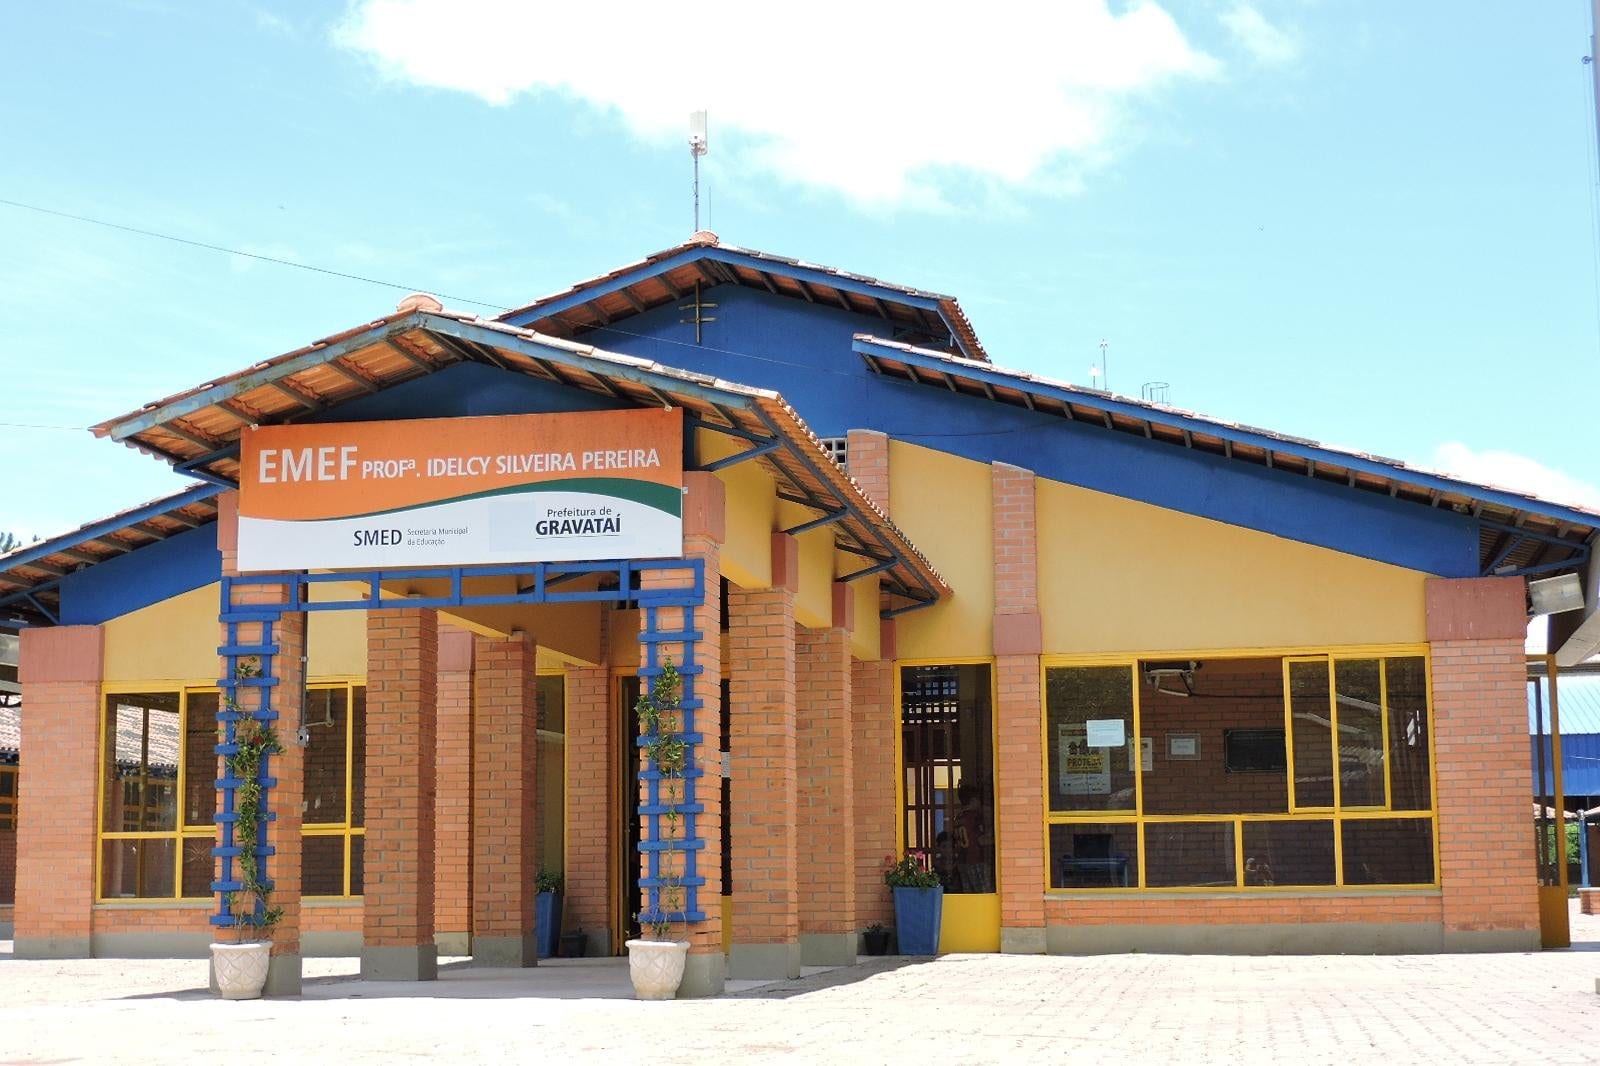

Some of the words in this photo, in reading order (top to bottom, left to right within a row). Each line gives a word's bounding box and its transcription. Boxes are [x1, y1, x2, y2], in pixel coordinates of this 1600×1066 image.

[258, 445, 358, 483] EMEF
[427, 455, 492, 477] IDELCY
[495, 452, 577, 475] SILVEIRA
[581, 448, 661, 470] PEREIRA
[547, 507, 596, 518] Prefeitura
[599, 506, 613, 517] de
[438, 527, 469, 535] Municipal
[535, 513, 621, 536] GRAVATAÍ
[353, 529, 403, 546] SMED
